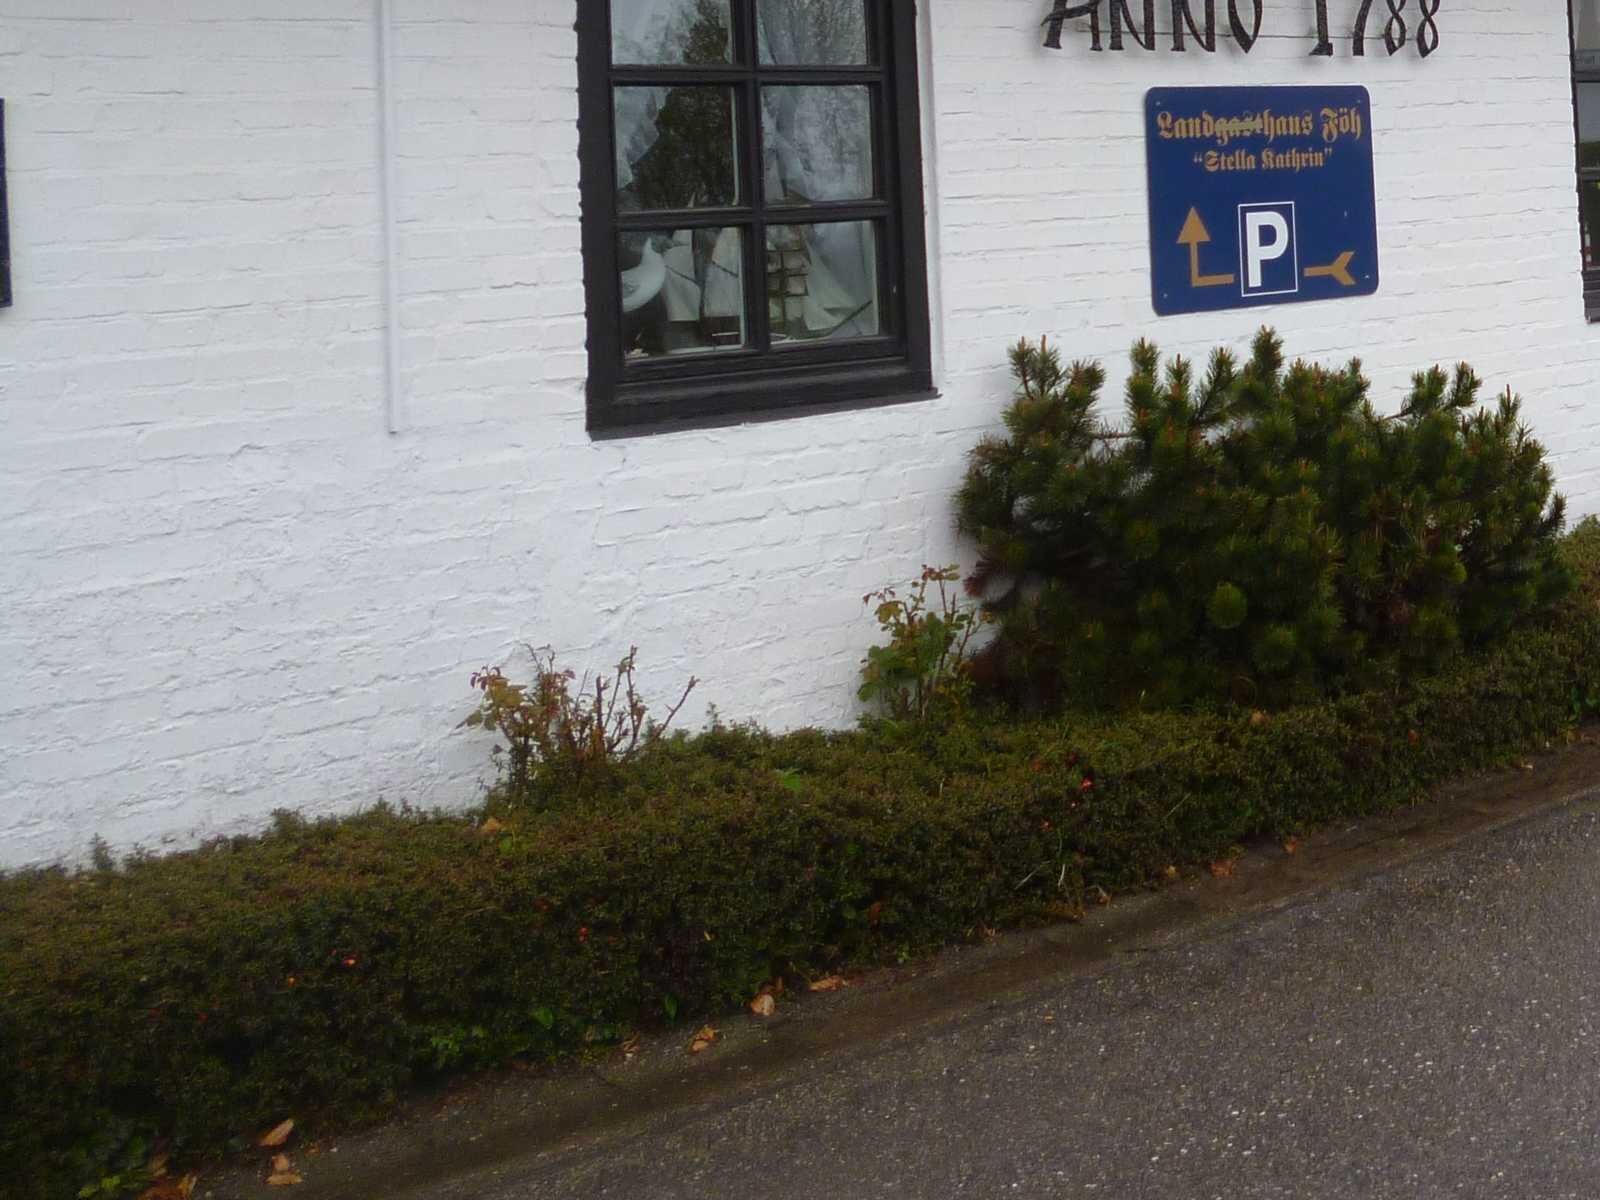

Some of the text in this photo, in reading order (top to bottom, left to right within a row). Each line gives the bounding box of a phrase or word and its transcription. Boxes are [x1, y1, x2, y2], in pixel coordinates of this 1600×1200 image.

[1156, 107, 1361, 146] Landgasthaus Föh
[1245, 211, 1289, 287] P
